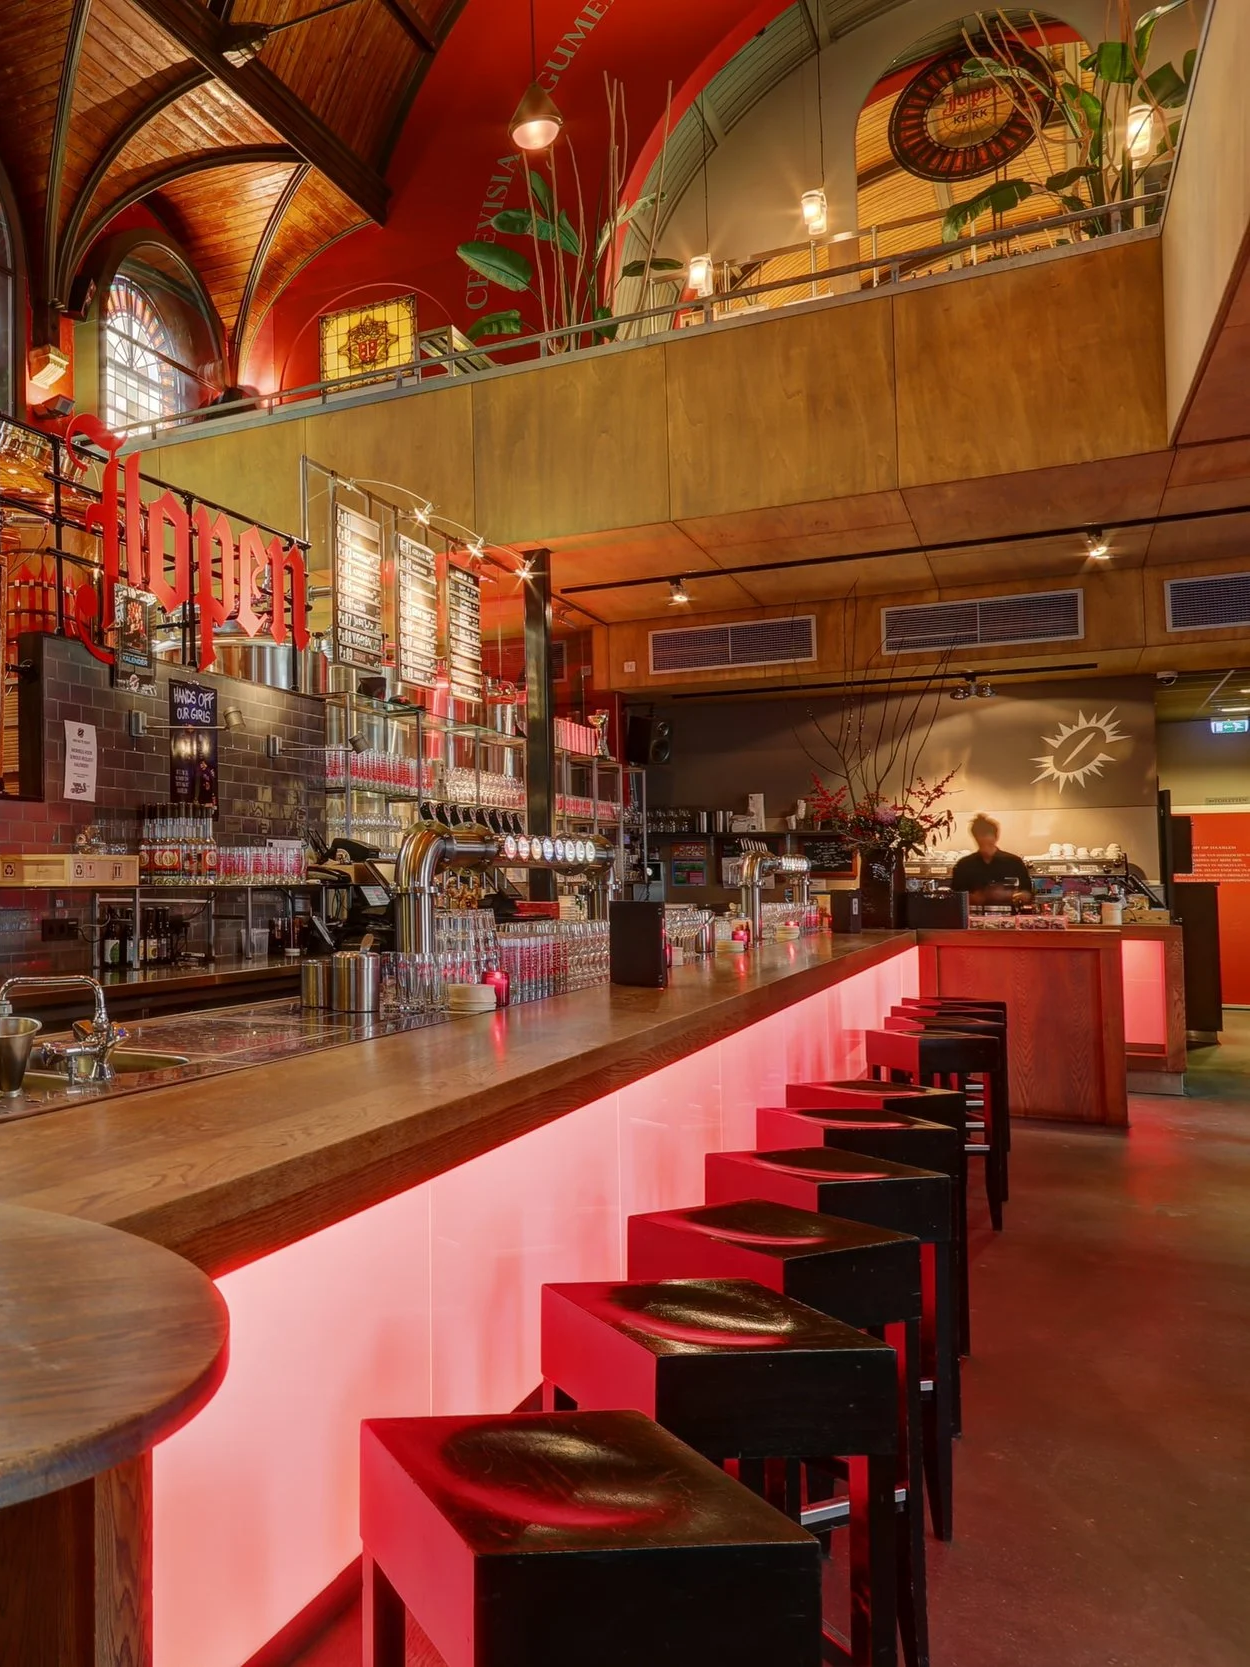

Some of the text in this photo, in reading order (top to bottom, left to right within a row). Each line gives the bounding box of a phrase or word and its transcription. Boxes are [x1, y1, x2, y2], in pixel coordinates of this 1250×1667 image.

[953, 109, 988, 124] KERK
[66, 413, 311, 673] Jopen
[173, 686, 215, 710] HANDS OFF
[176, 707, 211, 724] OUR GIRLS
